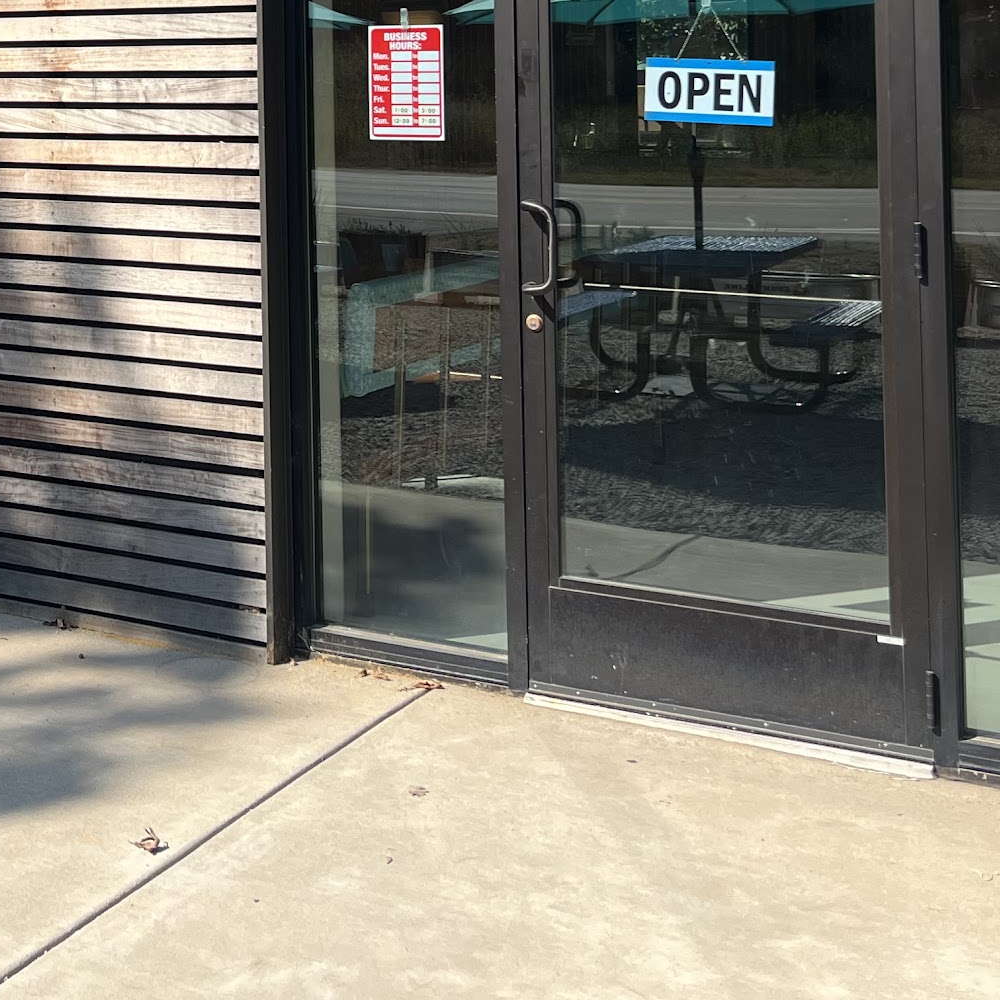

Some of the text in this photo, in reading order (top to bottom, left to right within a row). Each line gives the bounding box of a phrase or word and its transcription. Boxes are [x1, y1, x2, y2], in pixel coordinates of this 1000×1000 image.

[383, 32, 427, 42] BUSINESS
[389, 41, 422, 51] HOURS:
[372, 52, 390, 60] Mon.
[373, 63, 390, 71] Tues.
[373, 74, 390, 82] Wed.
[373, 84, 390, 92] Thur.
[657, 70, 762, 114] OPEN
[373, 95, 385, 103] Fri.
[373, 106, 387, 114] Sat.
[373, 117, 390, 125] Sun.
